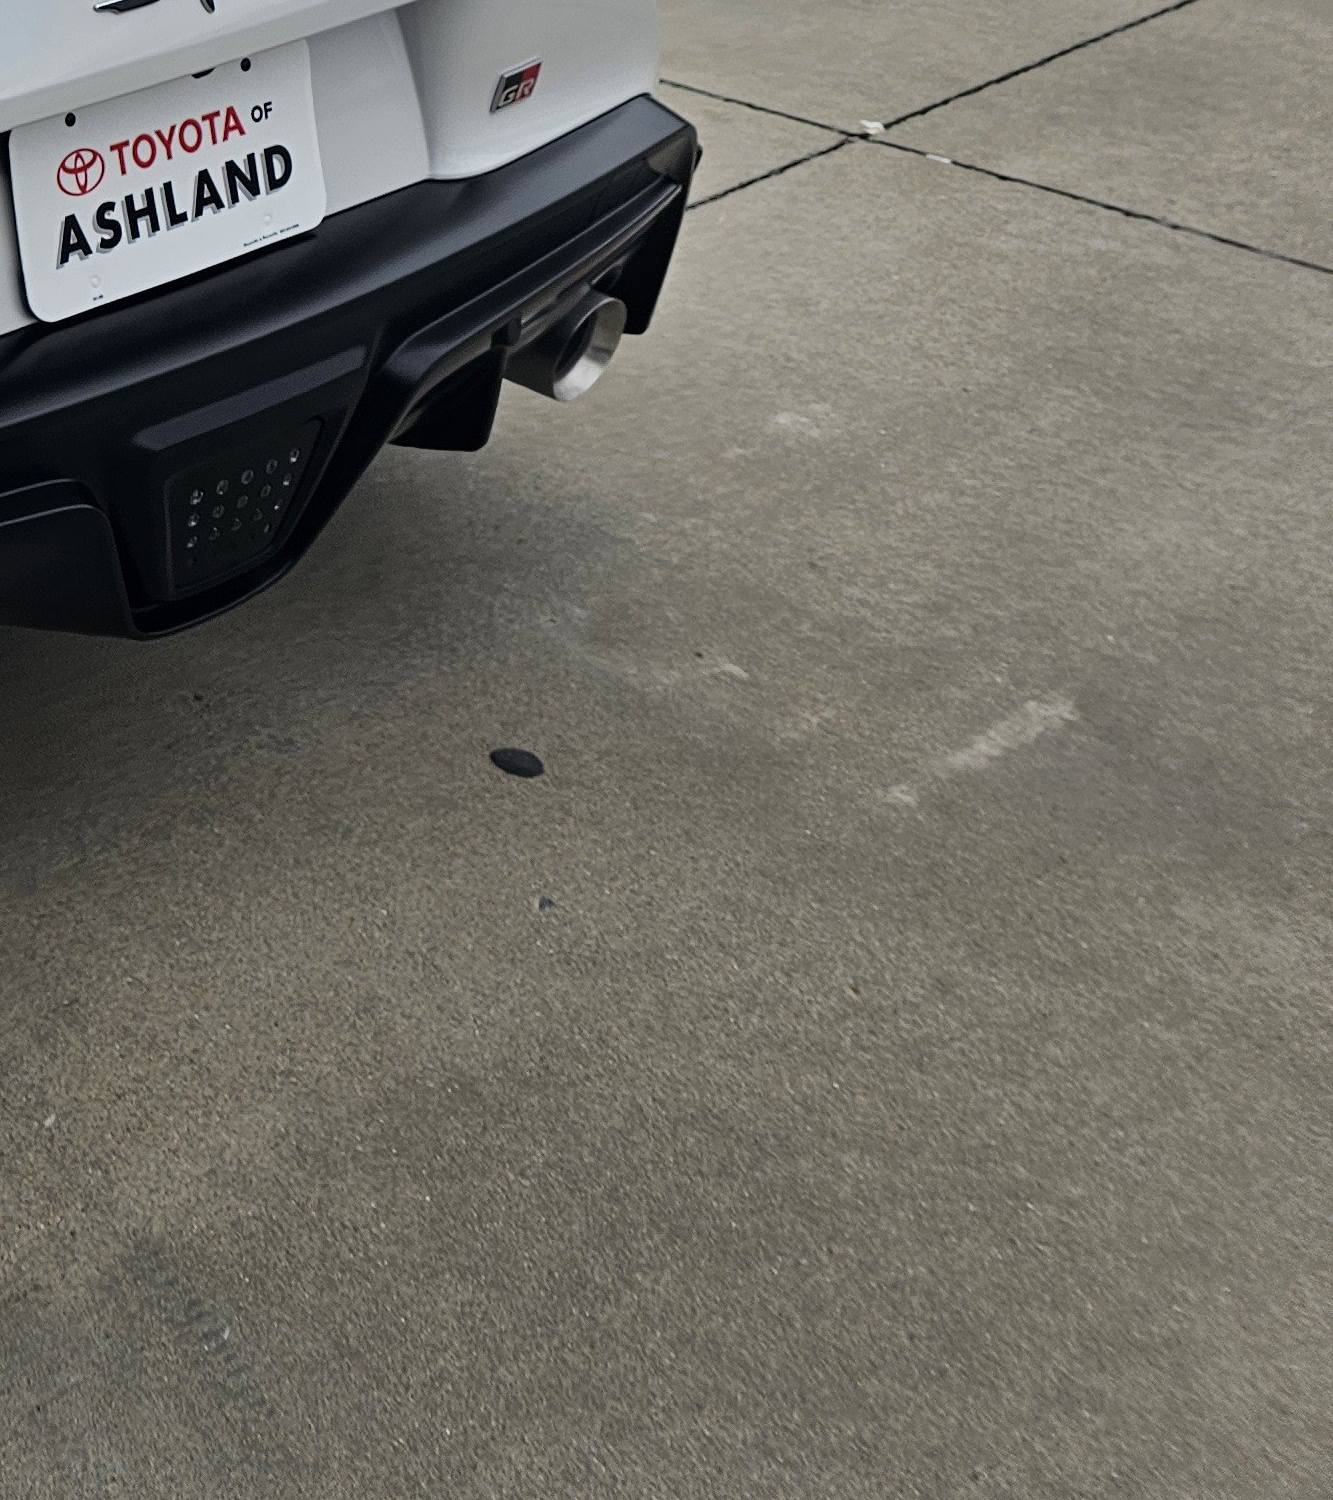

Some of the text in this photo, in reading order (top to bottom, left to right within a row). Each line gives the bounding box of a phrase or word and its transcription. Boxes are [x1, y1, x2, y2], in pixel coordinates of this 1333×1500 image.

[497, 77, 535, 107] GR
[110, 101, 274, 177] TOYOTA OF
[55, 143, 294, 269] ASHLAND
